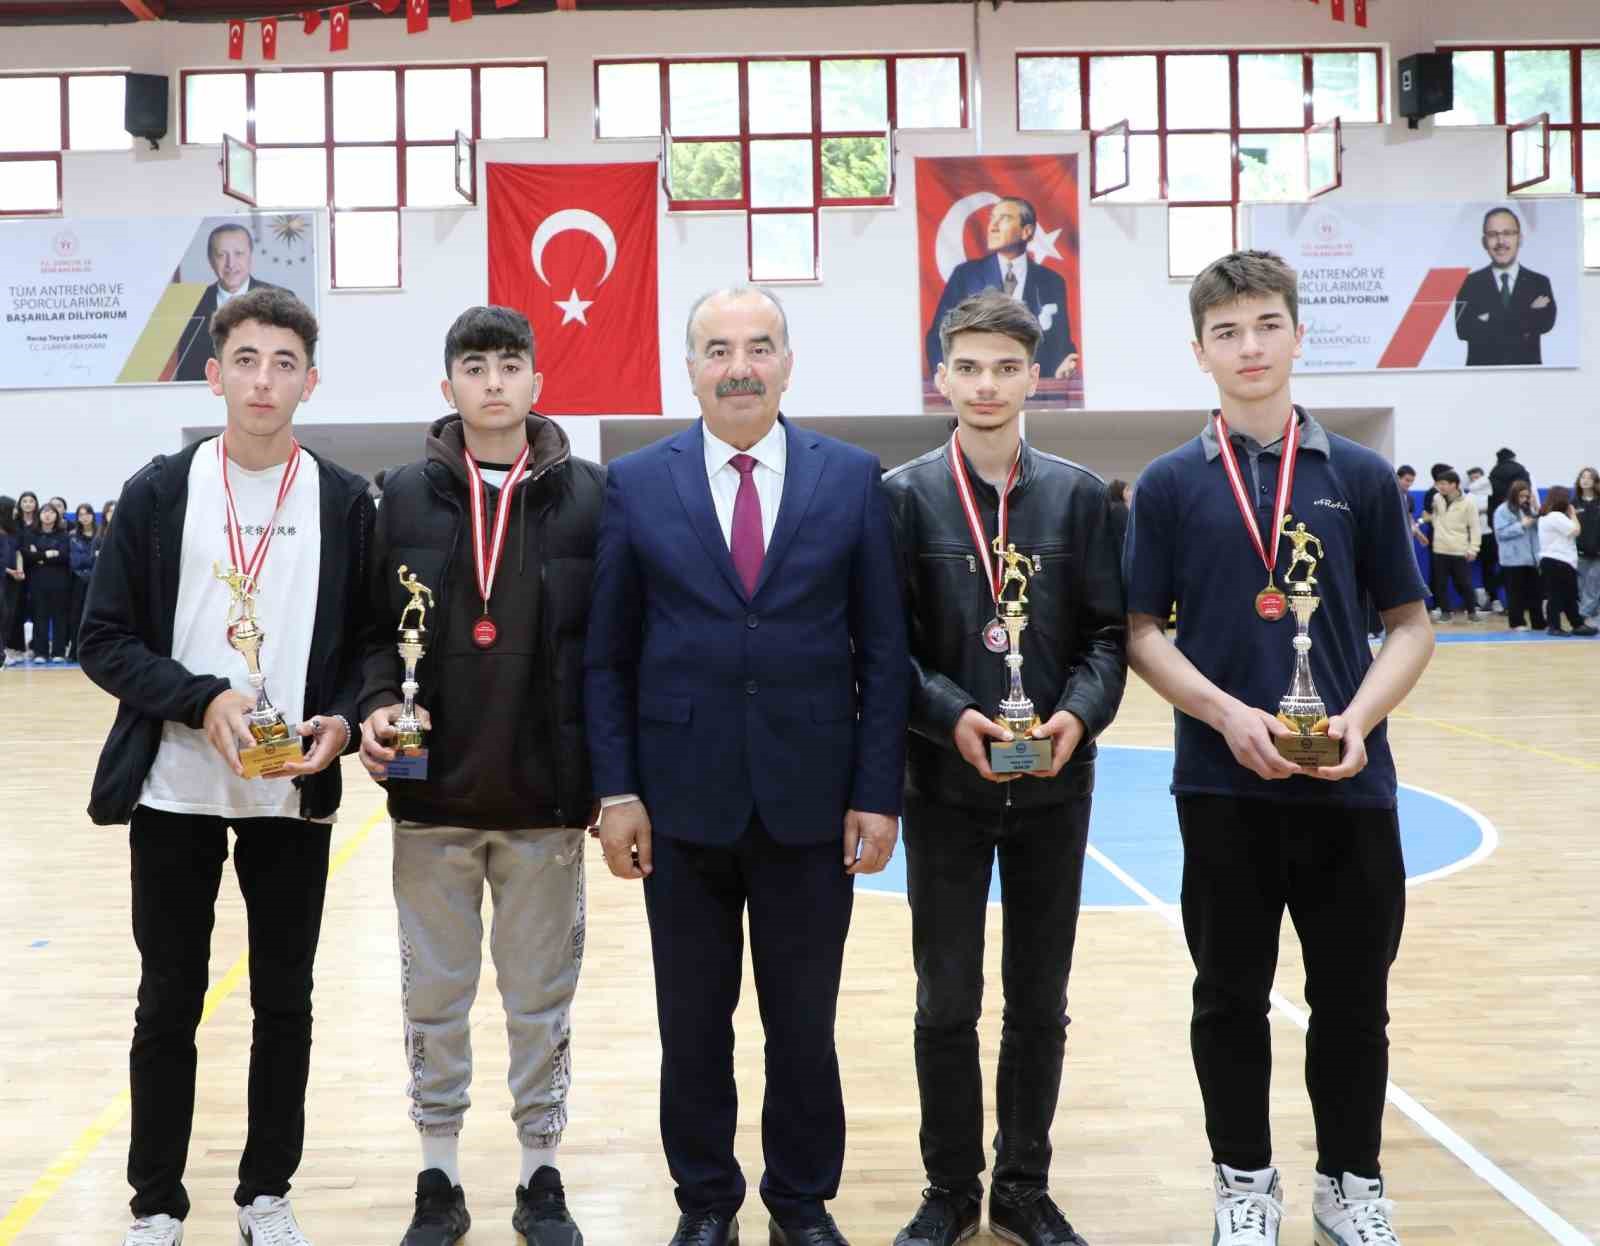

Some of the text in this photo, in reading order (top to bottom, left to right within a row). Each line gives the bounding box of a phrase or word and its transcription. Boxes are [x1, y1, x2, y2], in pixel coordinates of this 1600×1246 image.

[1371, 268, 1385, 279] VE
[8, 281, 125, 297] TÜM ANTRENÖR VE
[1297, 280, 1383, 293] RCULARIMIZA
[13, 295, 121, 310] SPORCULARIMIZA
[1297, 295, 1327, 305] RILAR
[6, 312, 65, 323] BAŞARILAR
